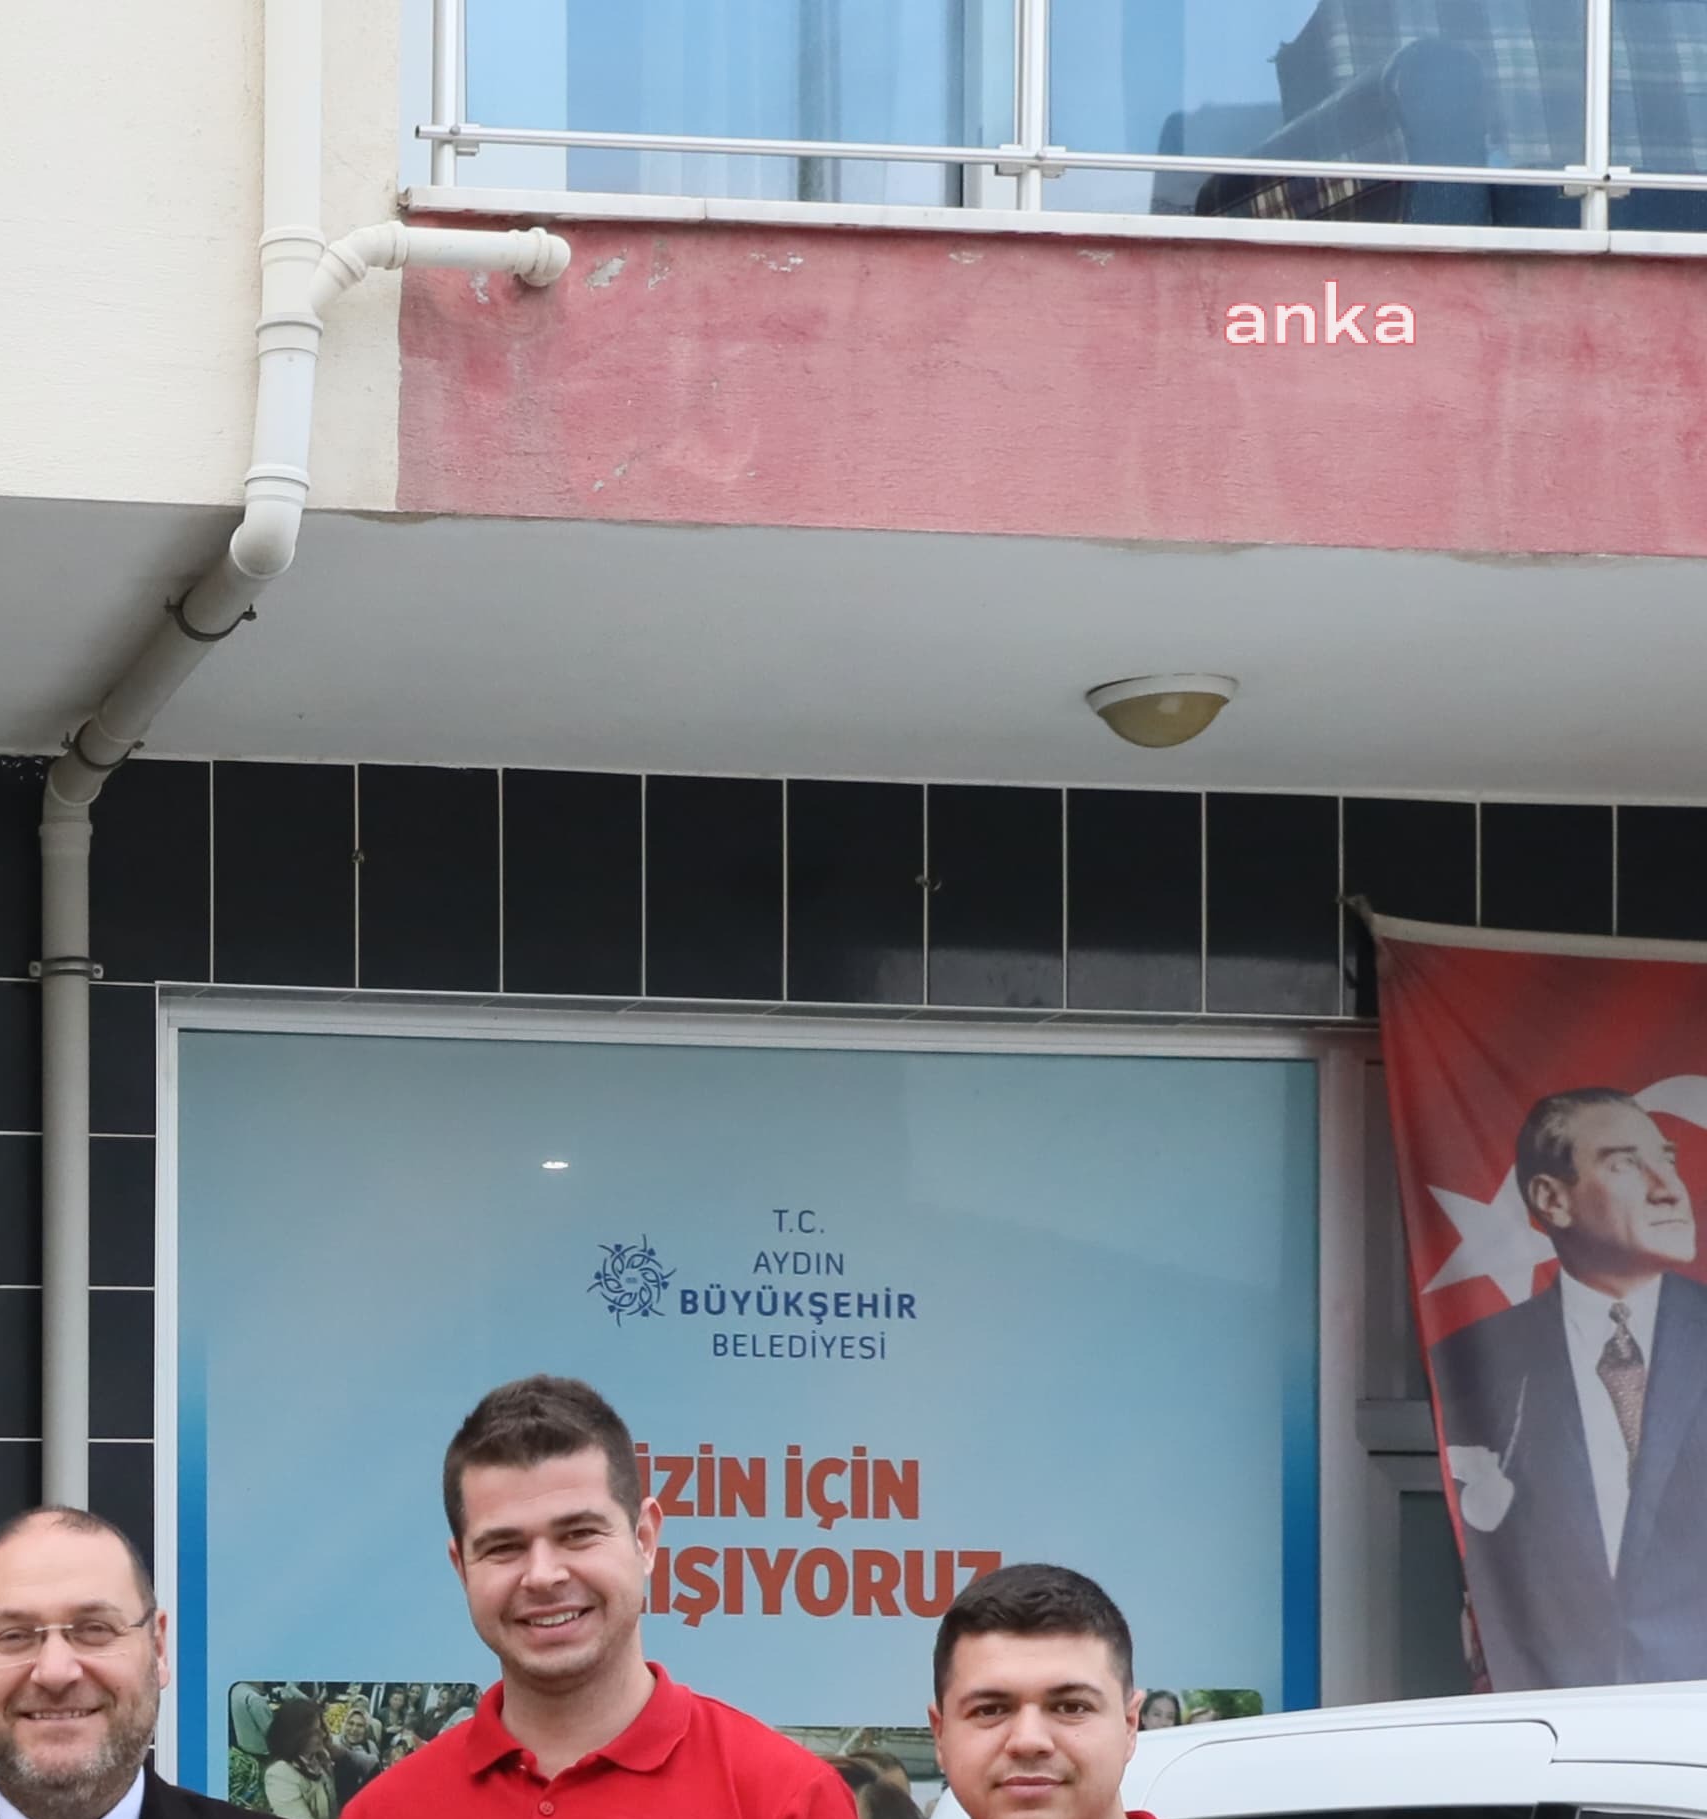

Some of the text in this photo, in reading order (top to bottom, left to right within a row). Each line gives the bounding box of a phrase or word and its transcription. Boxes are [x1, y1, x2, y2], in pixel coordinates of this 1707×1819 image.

[772, 1209, 825, 1234] T.C.
[753, 1251, 844, 1276] AYDIN
[679, 1283, 917, 1325] BÜYÜKŞEHİR
[712, 1330, 886, 1360] BELEDİYESİ
[634, 1442, 919, 1530] İZİN İÇİN
[642, 1546, 1002, 1628] IŞIYORUZ
